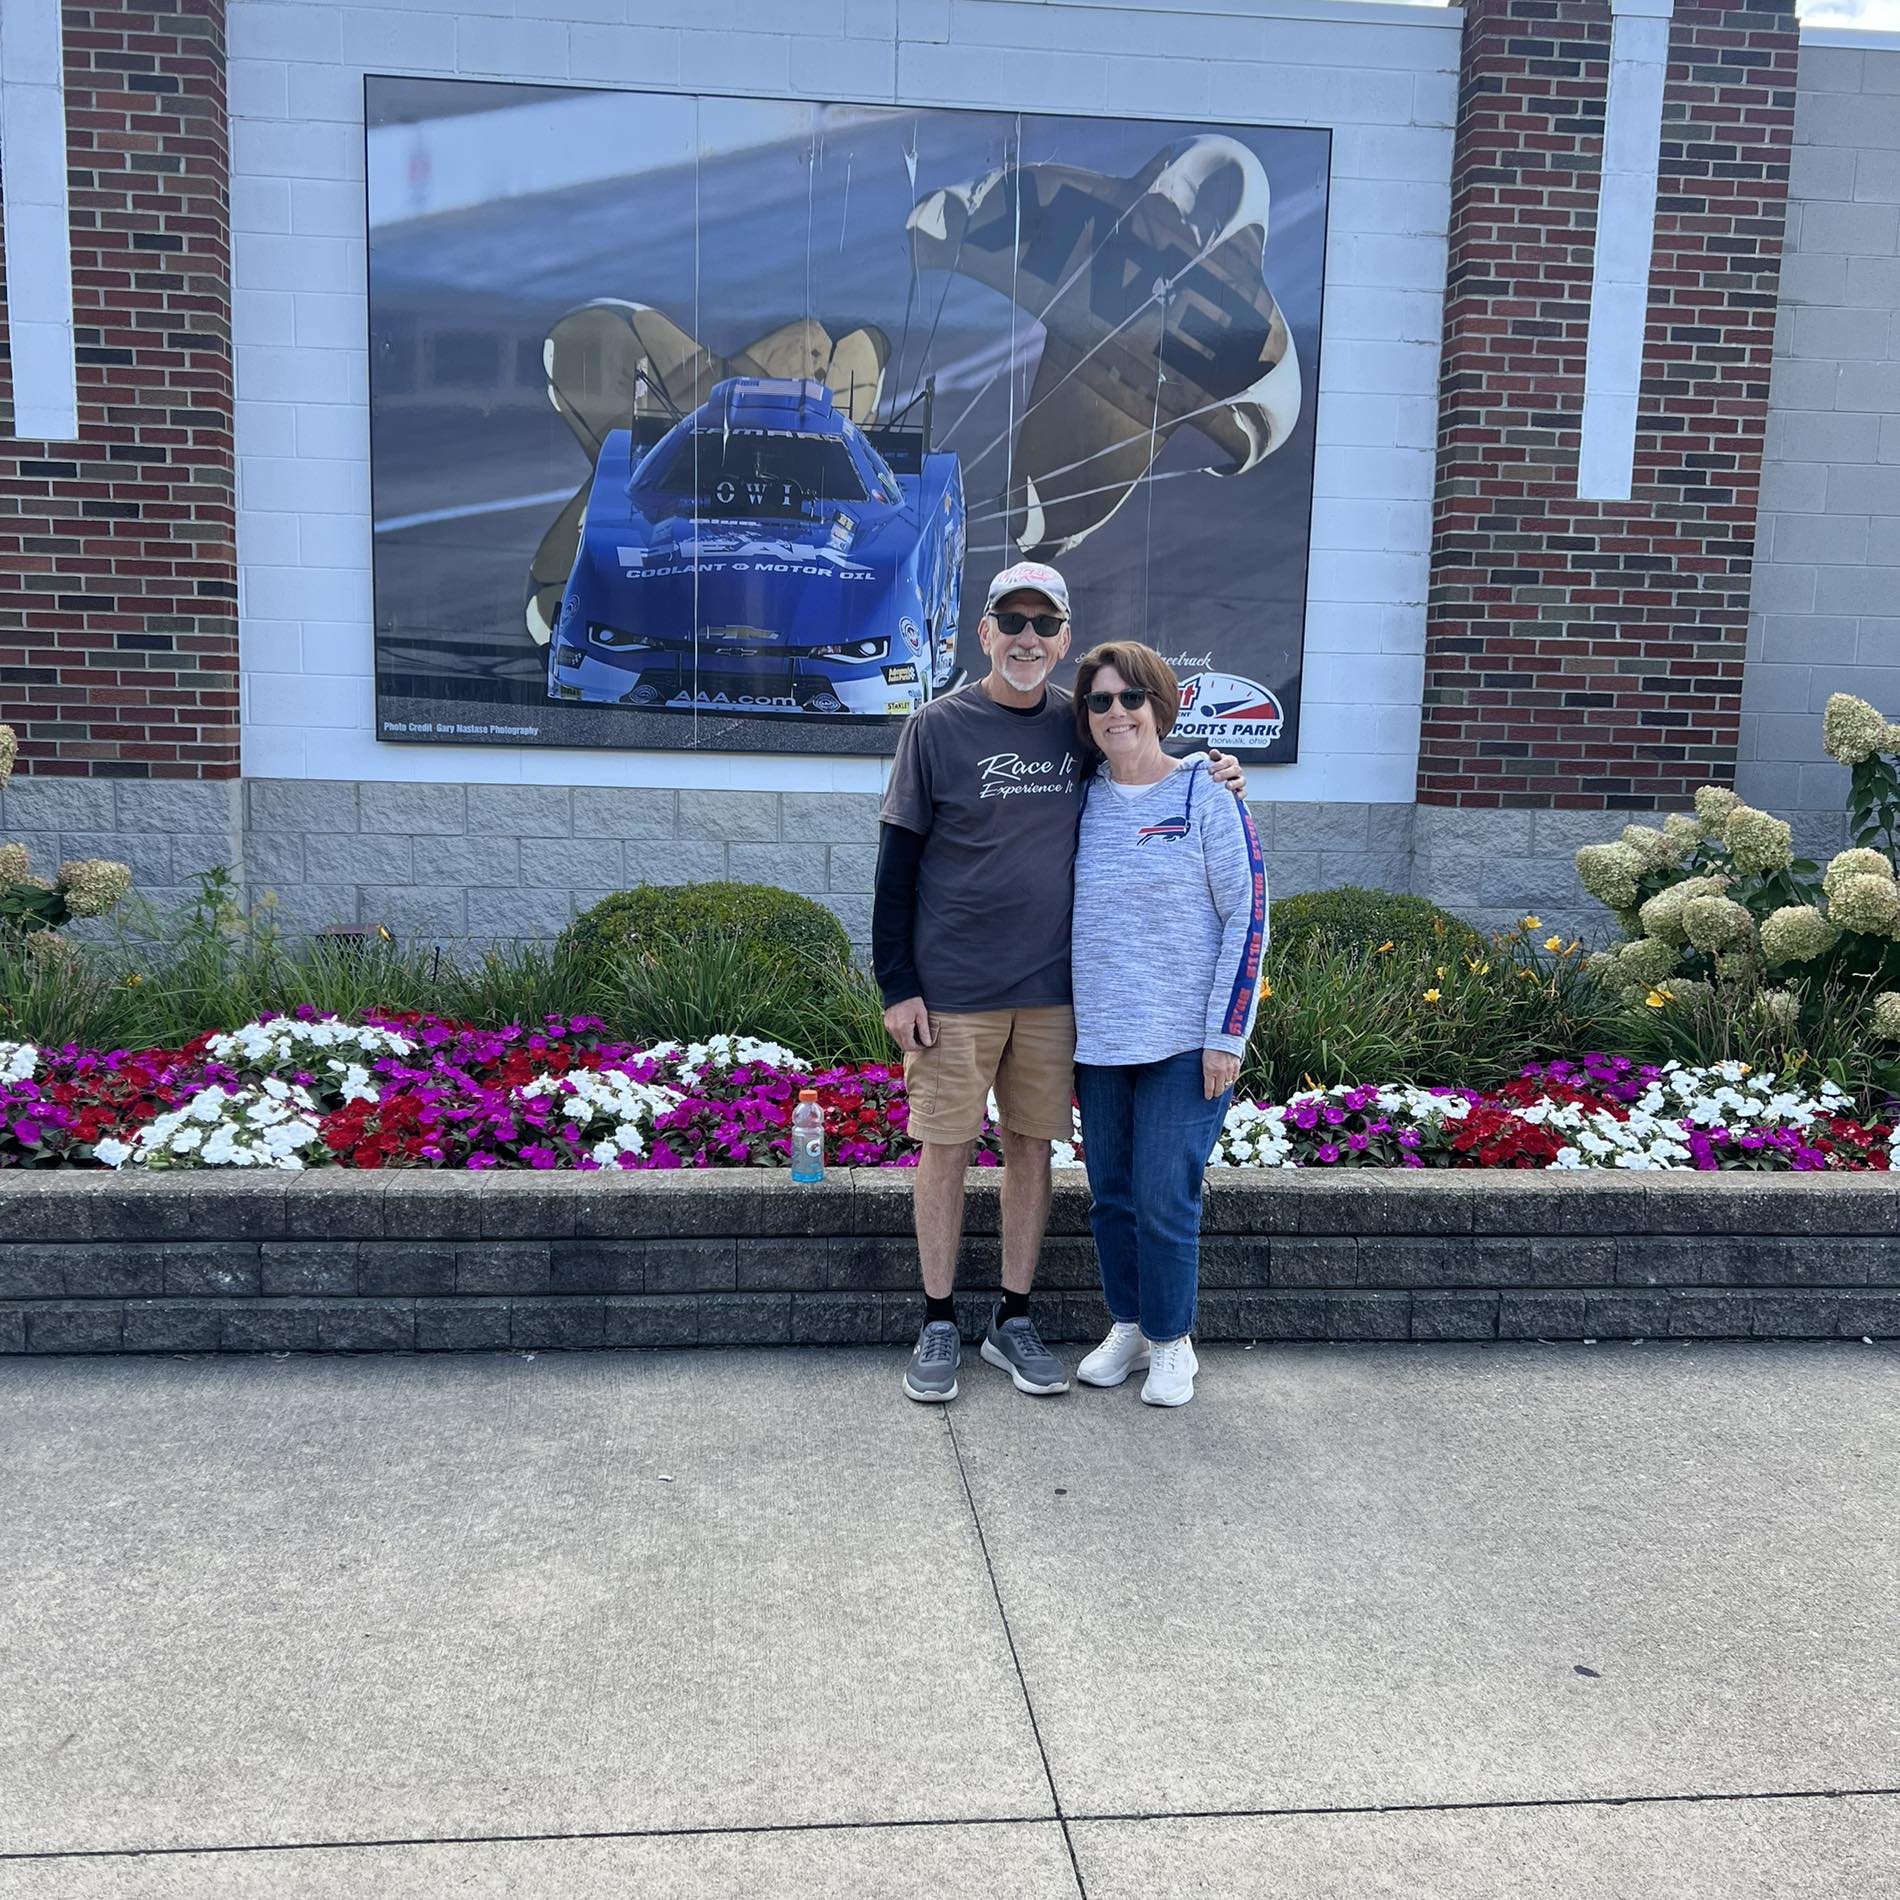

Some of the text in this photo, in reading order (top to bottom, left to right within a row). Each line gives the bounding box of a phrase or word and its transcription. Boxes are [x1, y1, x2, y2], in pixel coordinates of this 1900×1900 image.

[626, 563, 726, 578] COOLANT
[754, 563, 832, 577] MOTOR
[839, 571, 876, 581] OIL
[674, 690, 797, 706] AAA.com
[384, 722, 407, 731] Photo
[436, 723, 455, 734] Gary
[489, 725, 539, 736] Photography
[1172, 723, 1280, 737] PORTS PARK
[1249, 737, 1268, 745] ohio
[977, 752, 1079, 780] Race It
[980, 780, 1075, 800] Experience It
